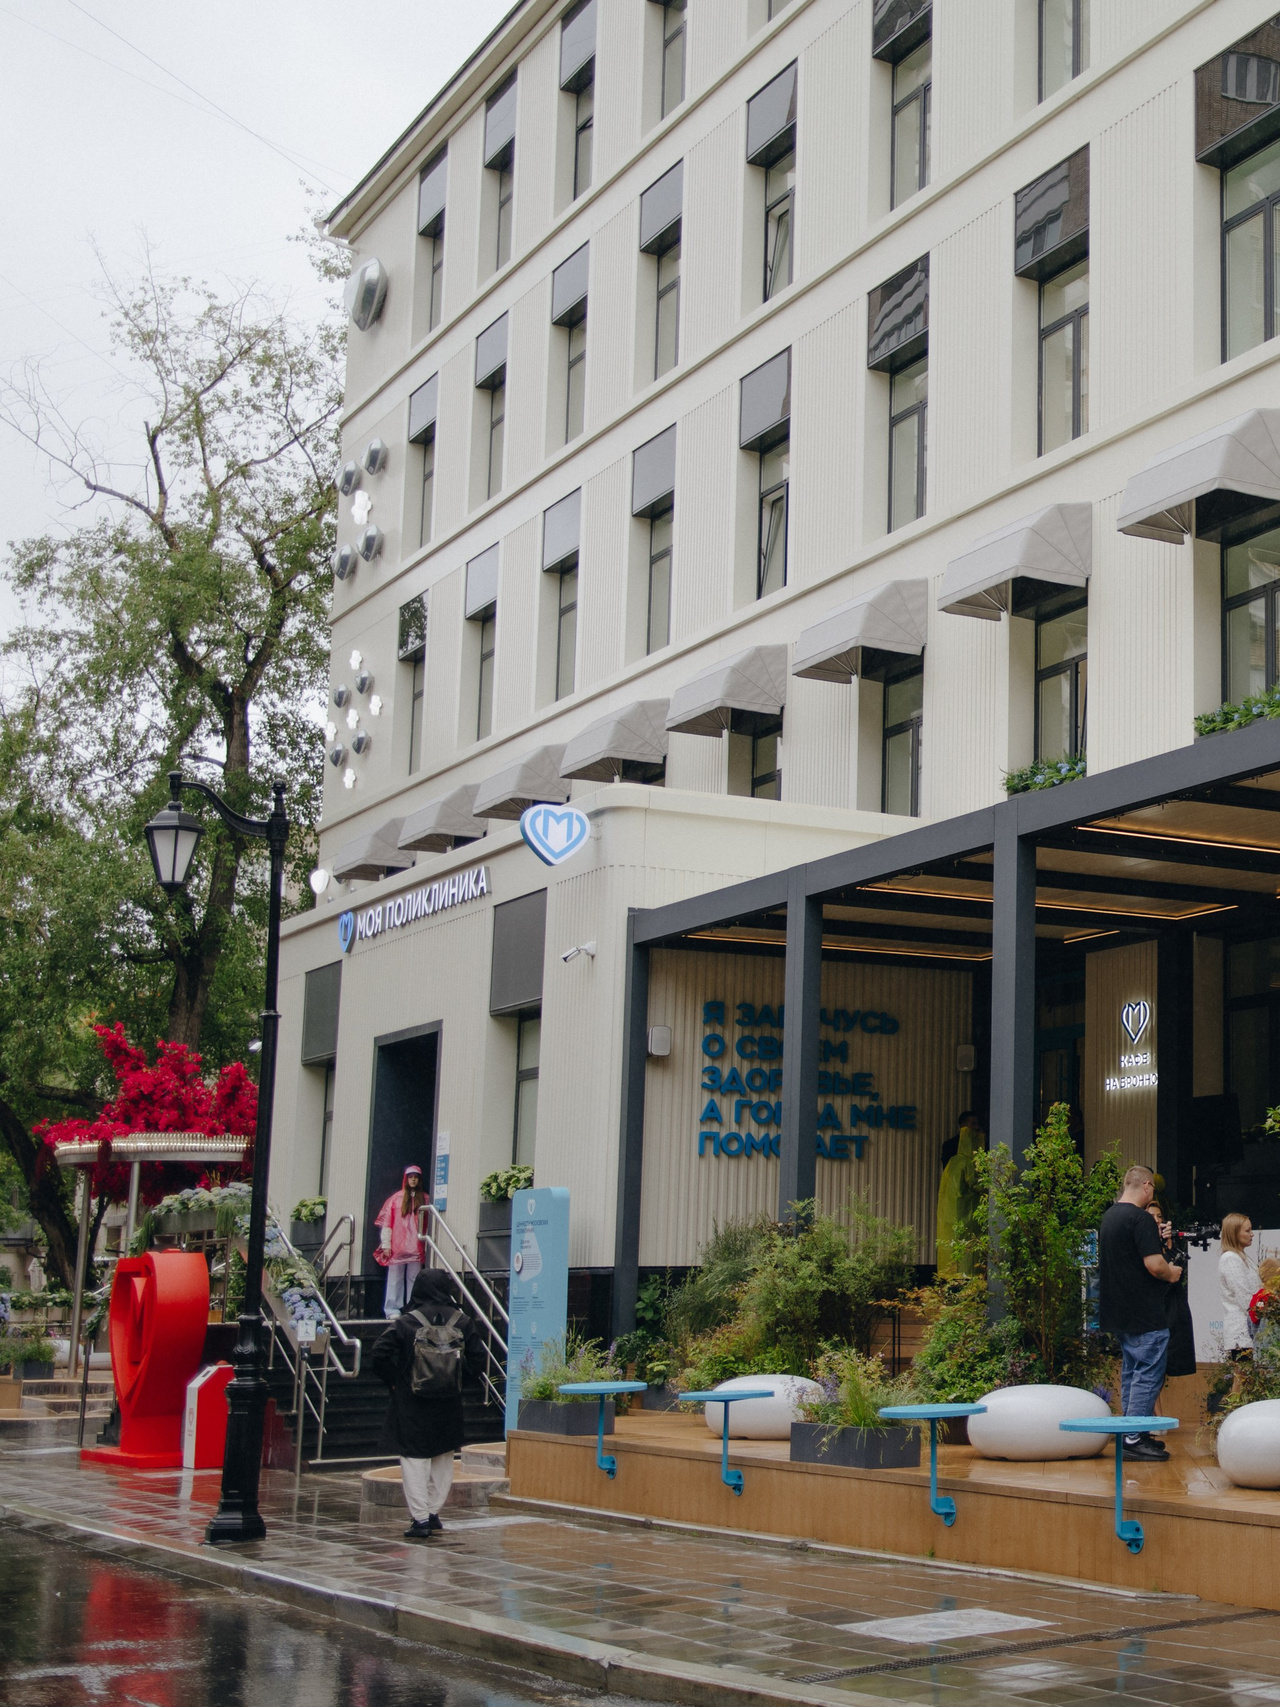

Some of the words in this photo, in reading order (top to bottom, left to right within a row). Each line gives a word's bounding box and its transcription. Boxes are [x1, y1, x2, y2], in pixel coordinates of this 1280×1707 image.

[356, 905, 383, 941] МОЯ
[385, 865, 488, 929] ПОЛИКЛИНИКА
[702, 1001, 726, 1026] Я
[735, 1003, 900, 1035] ЗАЧУСЬ
[701, 1033, 726, 1058] О
[735, 1035, 849, 1064] СВМ
[1120, 1052, 1150, 1068] КАФЕ
[701, 1065, 880, 1101] ЗДОРВЬЕ,
[1105, 1077, 1120, 1091] НА
[1120, 1073, 1159, 1089] БРОННО
[699, 1098, 723, 1124] А
[734, 1099, 842, 1131] ГОД
[850, 1103, 918, 1131] МНЕ
[698, 1131, 870, 1160] ПОМАЕТ
